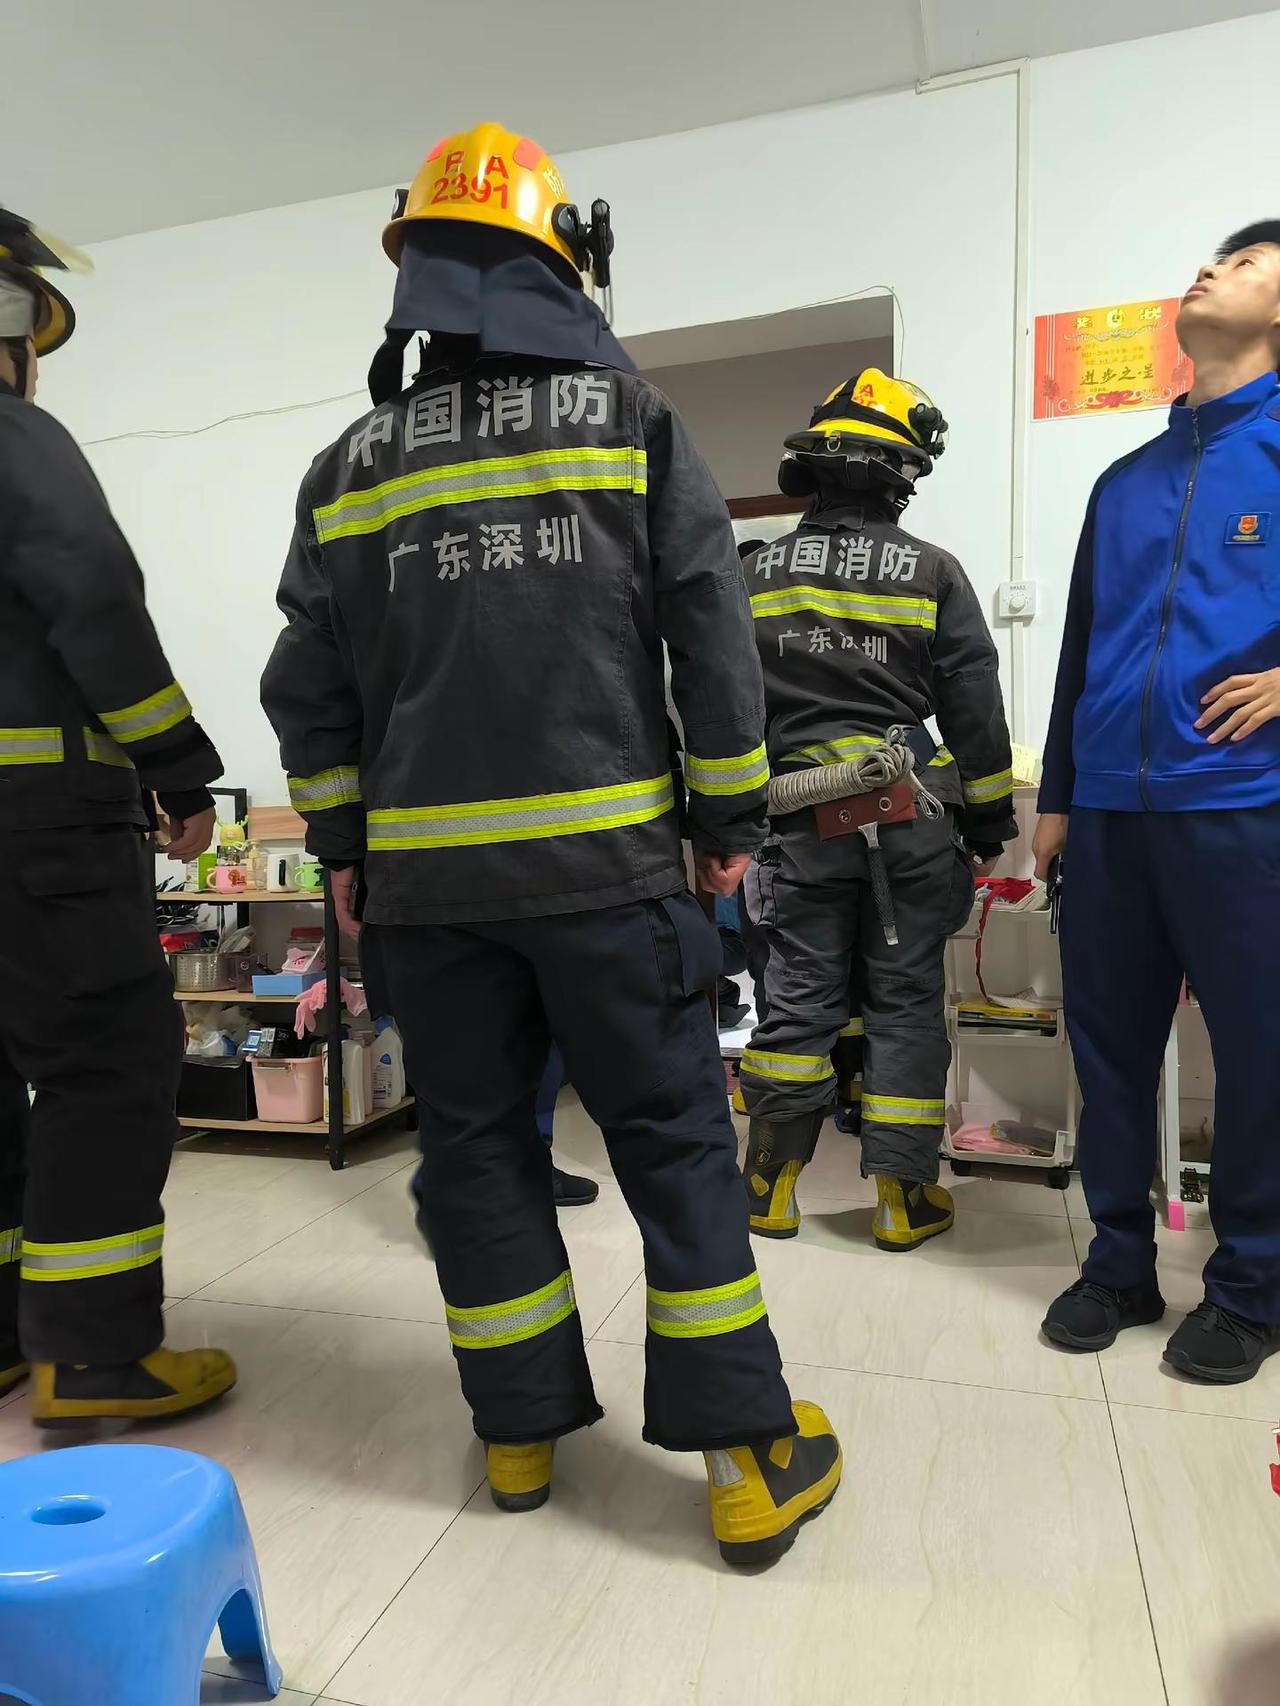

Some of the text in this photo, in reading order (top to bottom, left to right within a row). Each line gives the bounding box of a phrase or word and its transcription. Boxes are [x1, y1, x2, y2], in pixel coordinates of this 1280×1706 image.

[485, 154, 509, 179] A
[430, 172, 508, 209] 2391
[347, 374, 612, 467] 中国消防
[388, 514, 583, 593] 广东深圳
[755, 535, 921, 582] 中国消防
